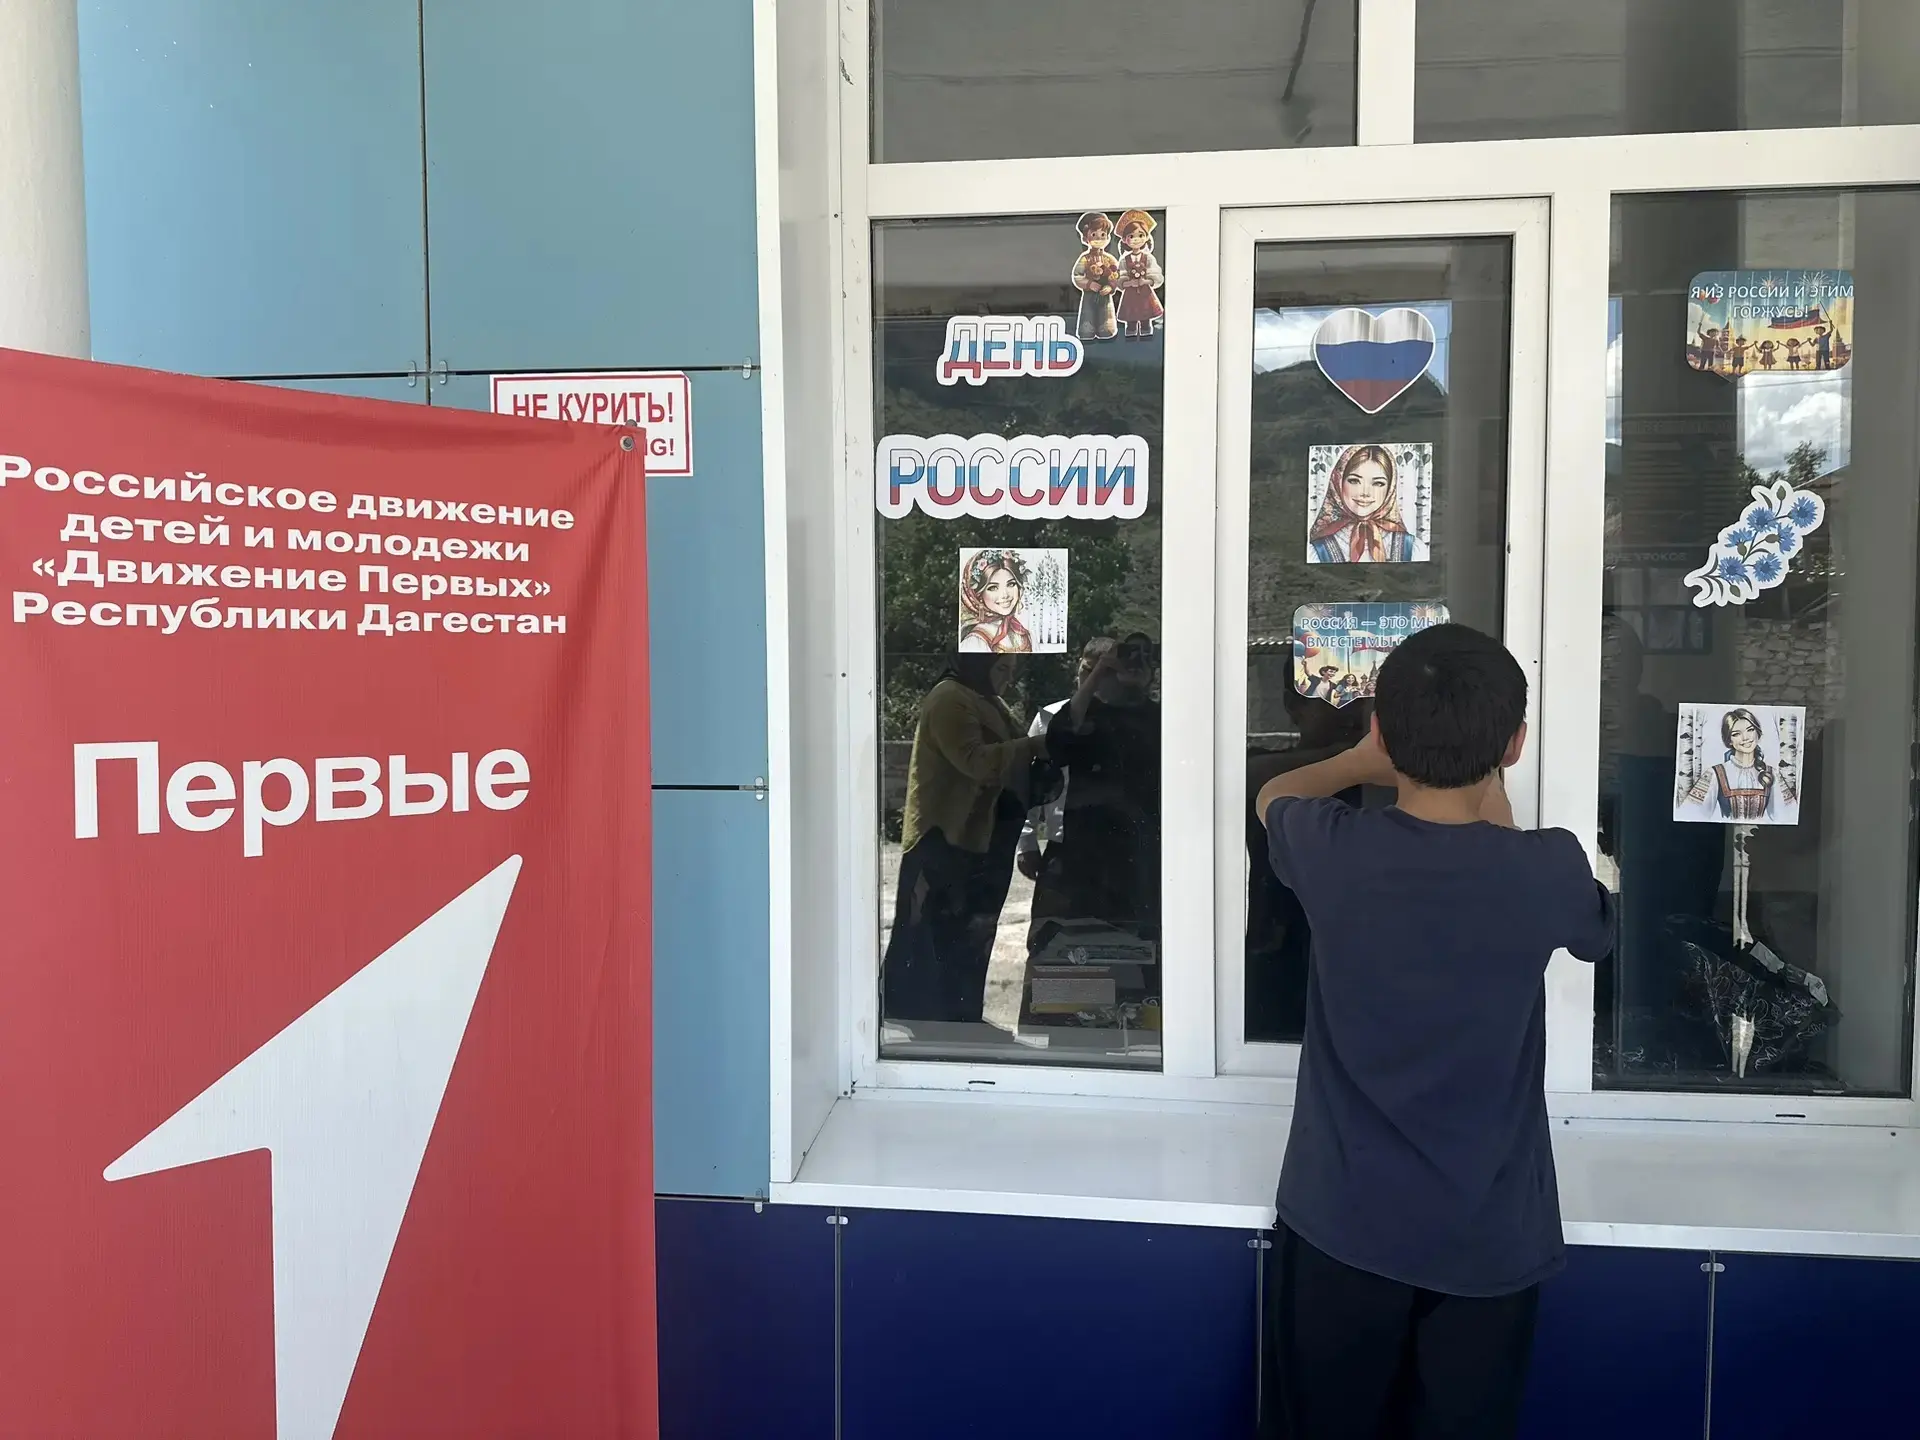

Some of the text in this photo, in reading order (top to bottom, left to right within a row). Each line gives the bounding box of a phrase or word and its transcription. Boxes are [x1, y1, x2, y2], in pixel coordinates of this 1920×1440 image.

[1691, 285, 1854, 298] Я ИЗ РОССИИ И ЭТИМ
[1733, 304, 1808, 319] ГОРЖУСЬ!
[943, 322, 1078, 378] ДЕНЬ
[512, 391, 674, 424] НЕ КУРИТЬ!
[0, 454, 575, 530] Российское движение
[889, 447, 1136, 506] РОССИИ
[60, 513, 530, 562] детей и молодежи
[32, 549, 551, 601] «Движение Первых»
[13, 591, 567, 637] Республики Дагестан
[1301, 616, 1358, 629] РОССИЯ
[1379, 616, 1409, 629] ЭТО
[1307, 636, 1362, 648] ВМЕСТЕ
[1367, 636, 1394, 648] МЫ
[74, 740, 531, 857] Первые
